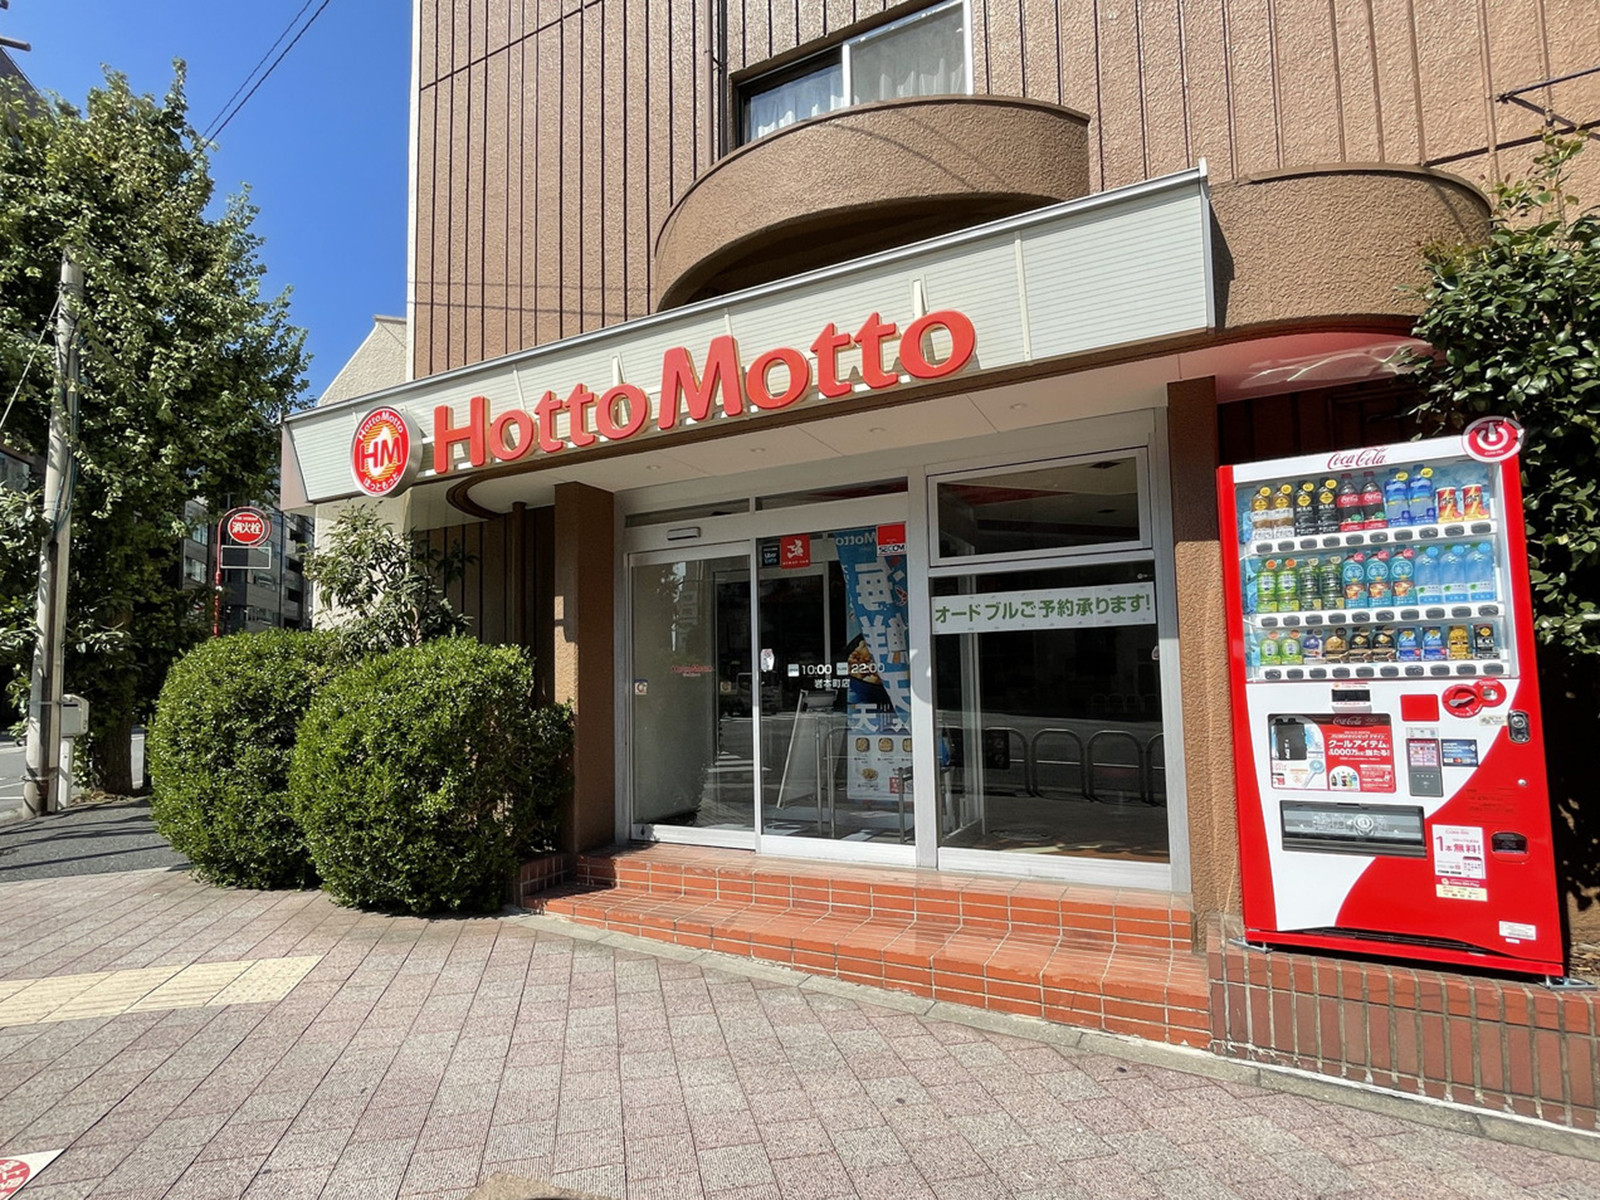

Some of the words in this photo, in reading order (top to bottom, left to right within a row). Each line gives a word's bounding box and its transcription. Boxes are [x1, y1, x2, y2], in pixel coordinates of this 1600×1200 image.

[361, 436, 402, 473] HM
[1327, 448, 1390, 471] Coca-Cola
[232, 521, 261, 534] 消火栓
[879, 544, 905, 554] SECOM
[935, 594, 1151, 623] オードブルご予約承ります!
[801, 664, 832, 675] 10:00
[851, 663, 884, 673] 22:00
[814, 679, 850, 688] 岩本町店
